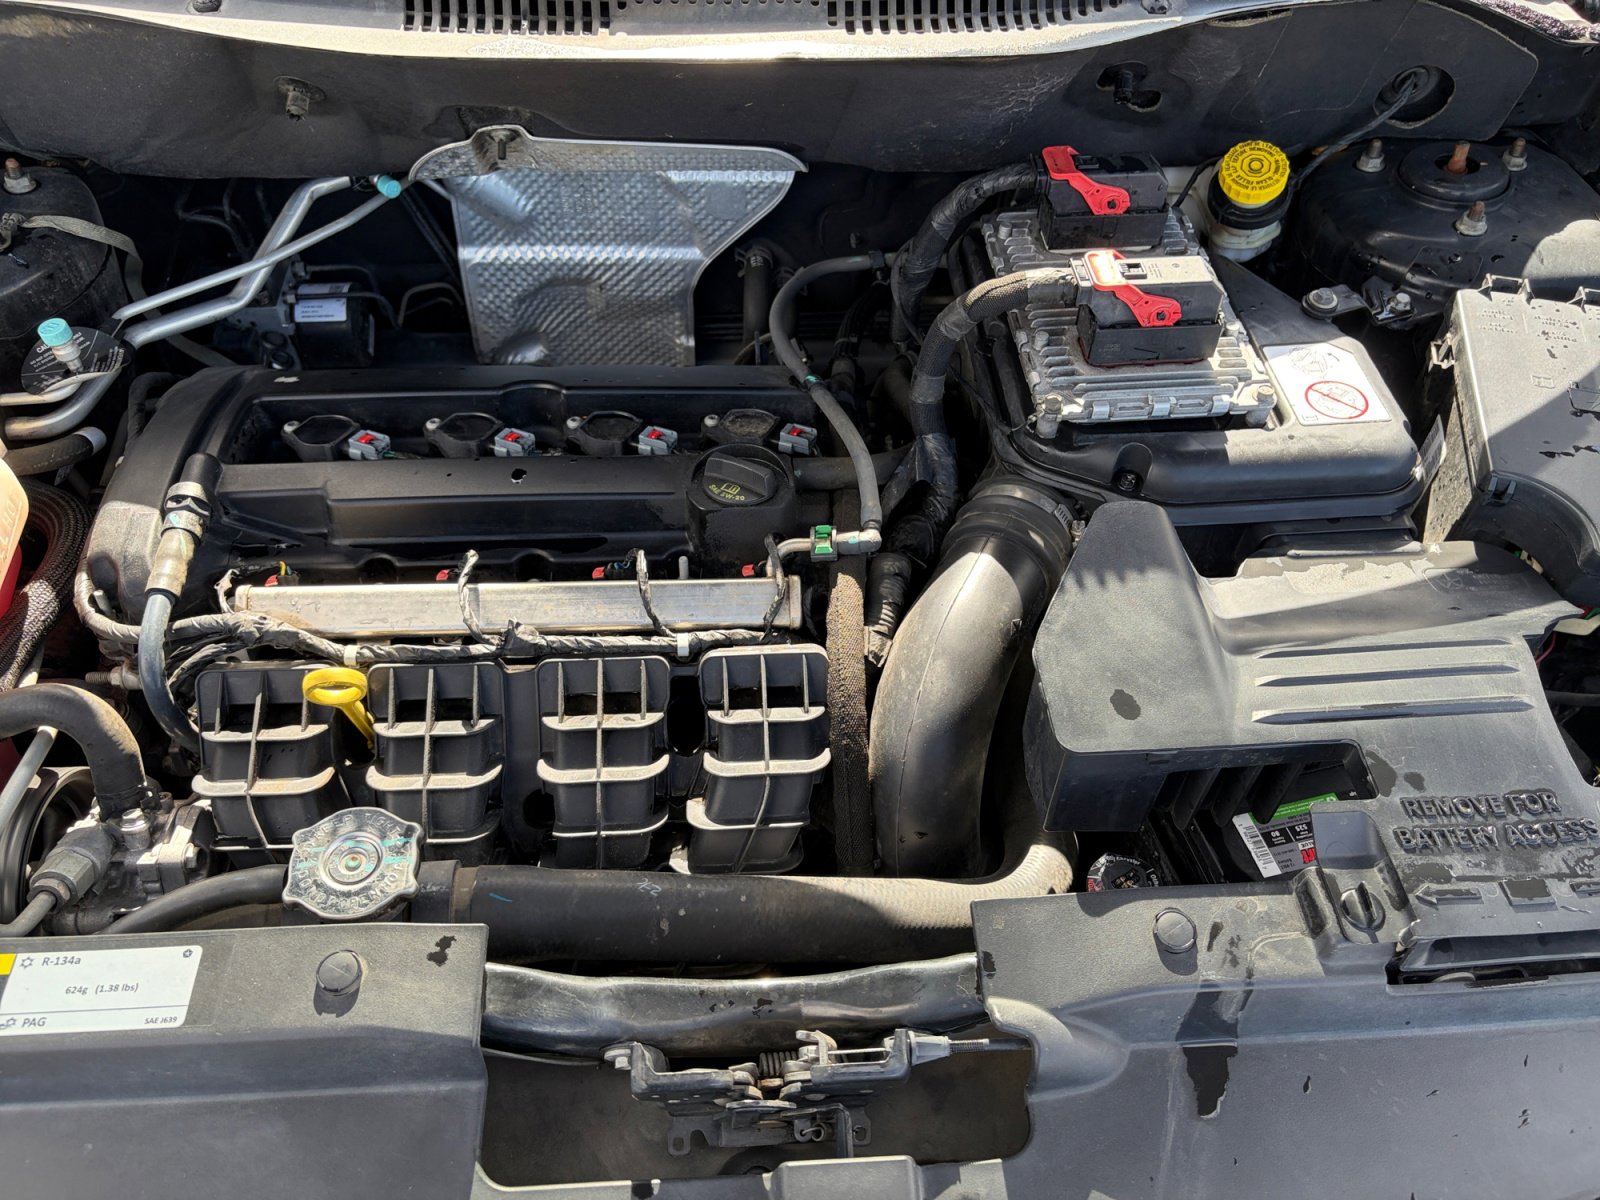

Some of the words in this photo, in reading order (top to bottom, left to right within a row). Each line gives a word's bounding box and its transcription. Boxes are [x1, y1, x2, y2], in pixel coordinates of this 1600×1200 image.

[709, 484, 720, 494] SAE
[720, 492, 745, 501] 5W-20
[1401, 794, 1506, 819] REMOVE
[1504, 791, 1562, 816] FOR
[1295, 823, 1308, 832] 525
[1394, 825, 1500, 850] BATTERY
[1504, 817, 1600, 847] ACCESS
[42, 956, 82, 966] R-134a
[65, 986, 88, 995] 624g
[94, 983, 120, 995] (1.38
[121, 982, 139, 993] lbs)
[22, 1016, 47, 1027] PAG
[144, 1017, 159, 1025] SAE
[160, 1016, 178, 1024] J639
